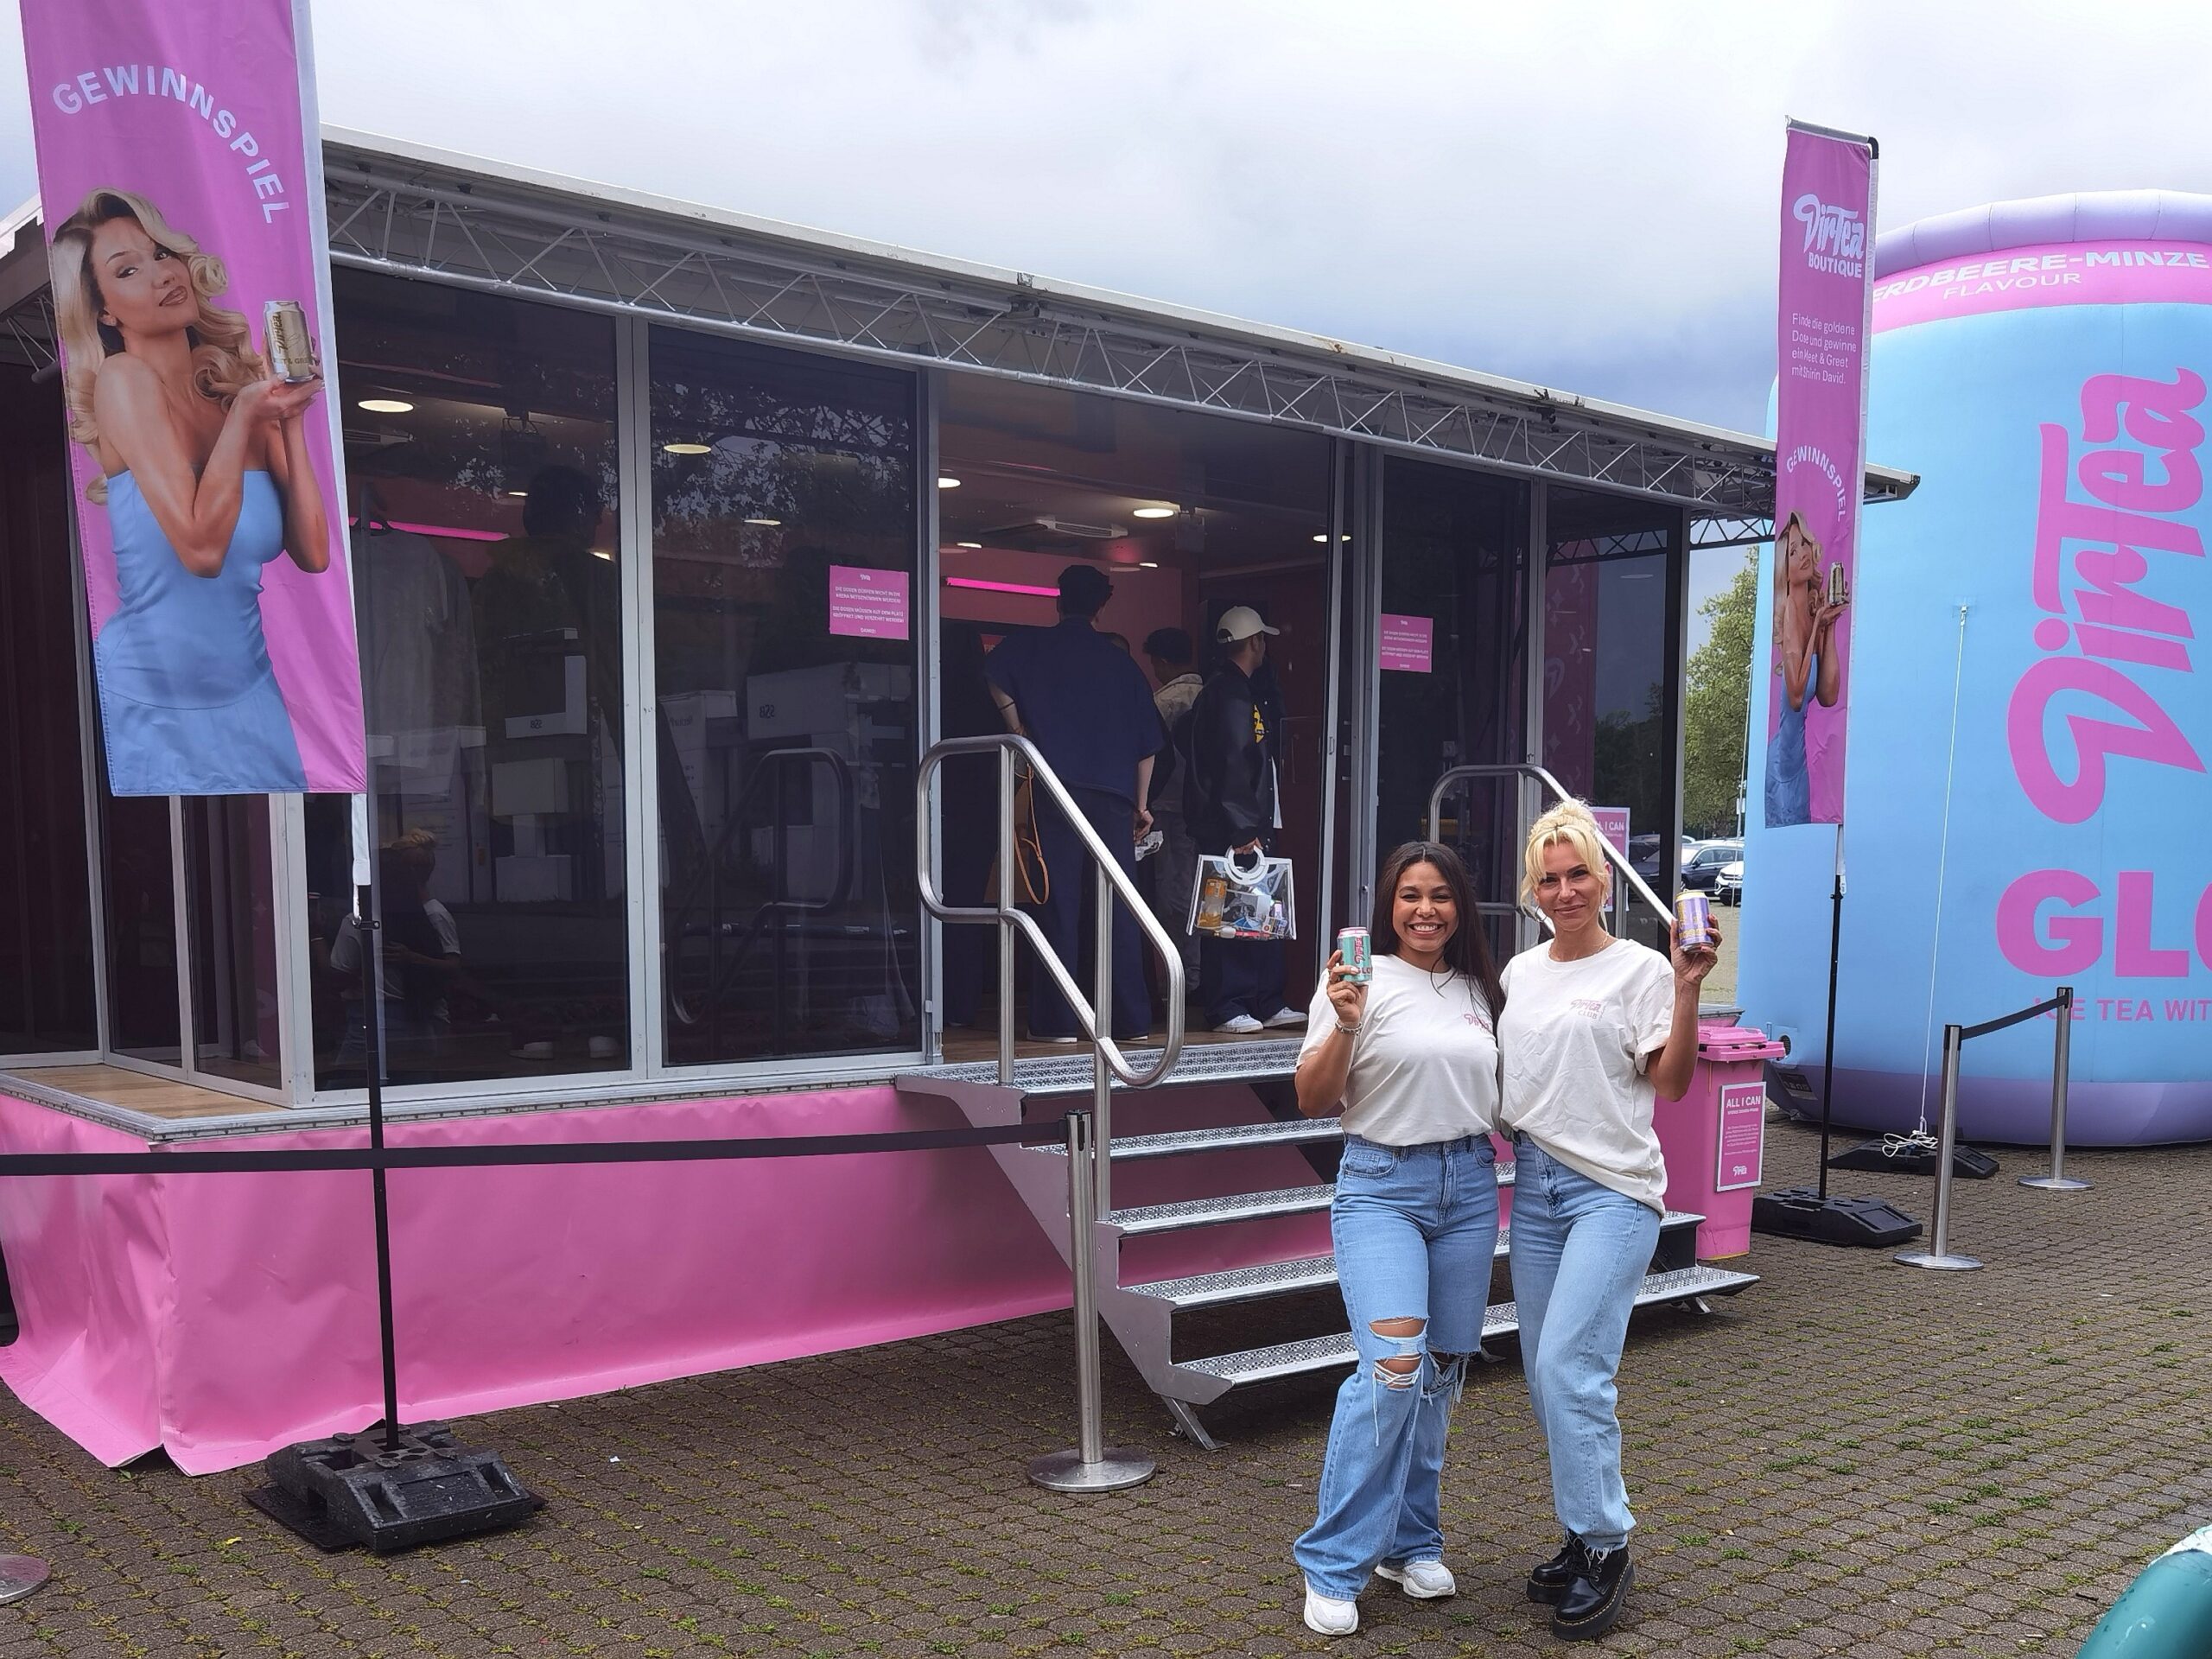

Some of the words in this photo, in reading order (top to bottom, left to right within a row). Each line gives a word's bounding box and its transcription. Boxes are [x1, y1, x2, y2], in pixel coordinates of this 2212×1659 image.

[52, 64, 289, 225] GEWINNSPIEL
[1808, 251, 1863, 278] BOUTIQUE
[1872, 251, 2211, 303] ERDBEERE-MINZE
[1942, 272, 2082, 301] FLAVOUR
[1792, 313, 1812, 328] Finde
[1812, 318, 1823, 330] die
[1823, 321, 1856, 336] goldene
[1792, 329, 1809, 345] Dose
[1809, 335, 1823, 347] und
[1824, 338, 1858, 353] gewinne
[1792, 346, 1804, 361] ein
[1819, 353, 1826, 365] &
[1826, 353, 1849, 368] Greet
[1822, 370, 1847, 385] David.
[1786, 445, 1847, 522] GEWINNSPIEL
[1996, 868, 2212, 978] GL
[1578, 1010, 1598, 1020] CLUB
[2097, 999, 2154, 1021] TEA
[1726, 1097, 1740, 1108] ALL
[1745, 1096, 1761, 1106] CAN
